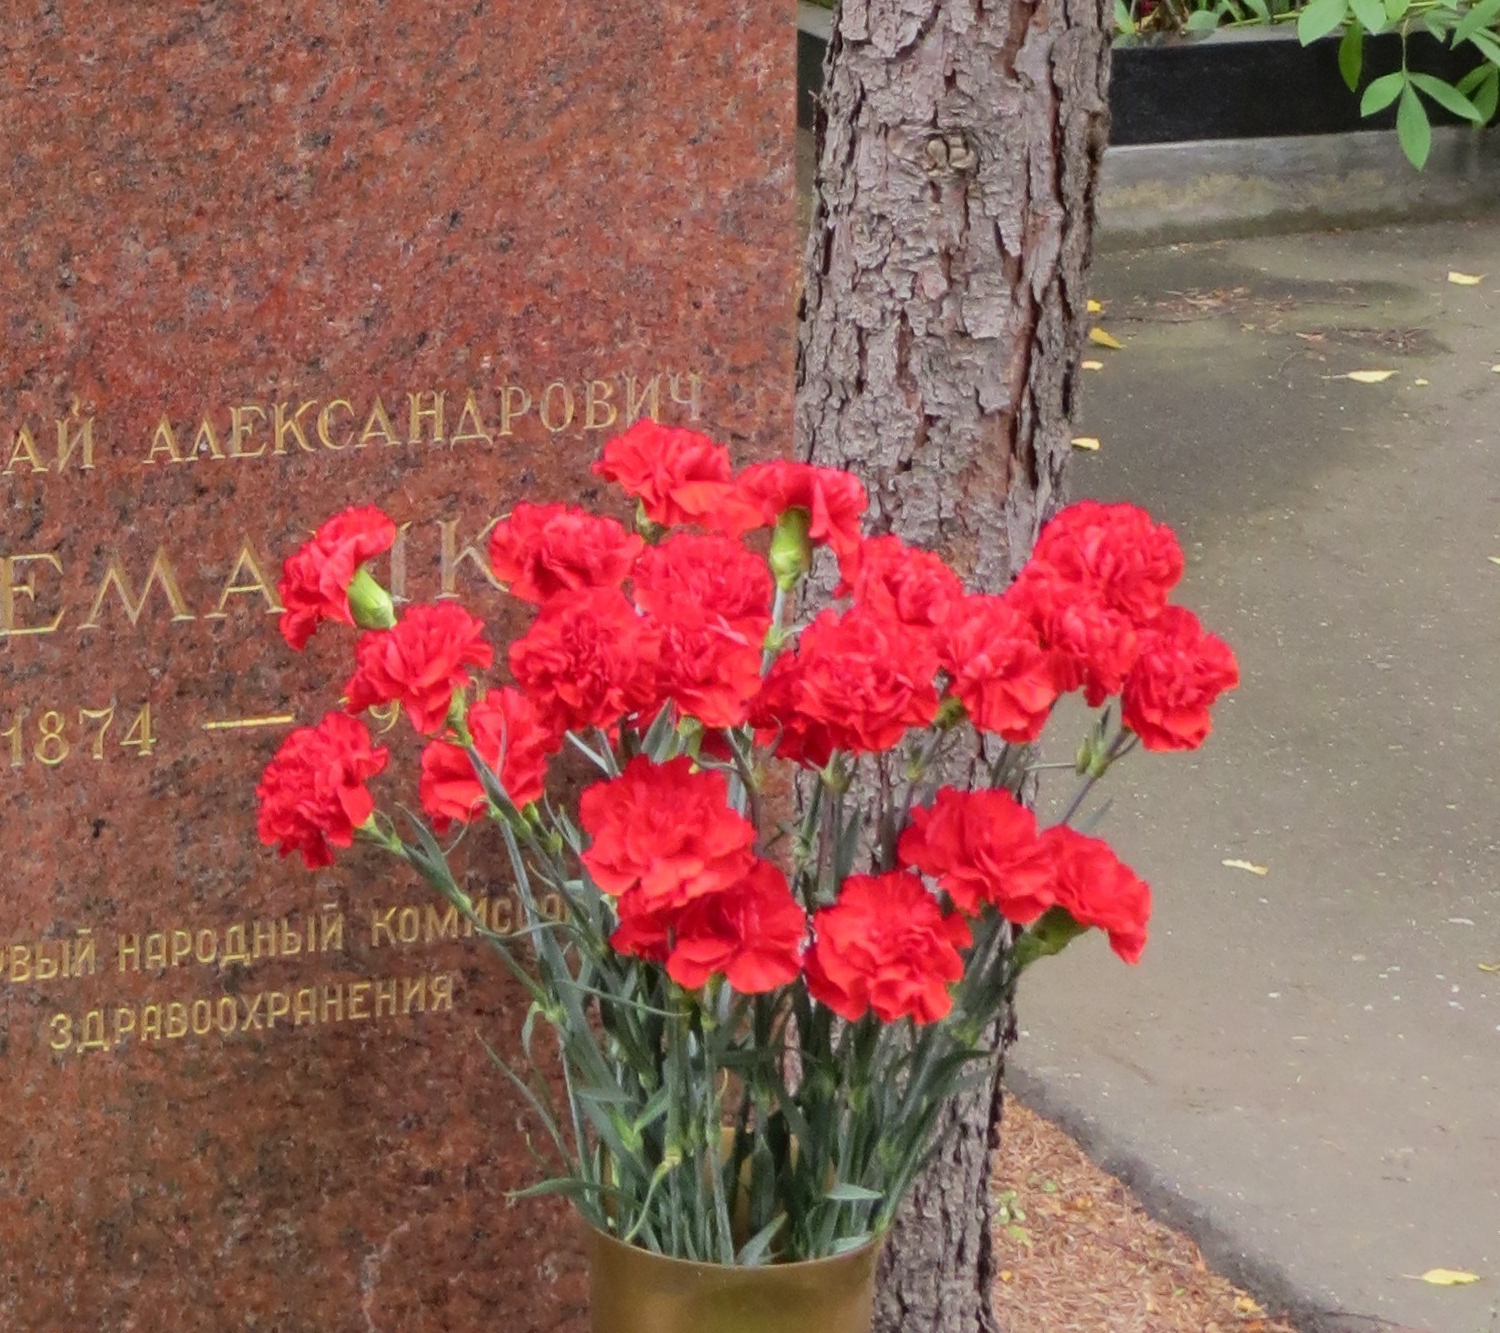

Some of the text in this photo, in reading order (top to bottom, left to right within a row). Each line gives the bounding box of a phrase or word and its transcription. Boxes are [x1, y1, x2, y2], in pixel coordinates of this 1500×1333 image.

[141, 369, 704, 464] АЛЕКСАНДРОВИЧ
[1, 700, 157, 768] 1874
[117, 900, 344, 972] НАРОДНЫЙ
[50, 970, 453, 1053] ЗДРАВООХРАНЕНИЯ
